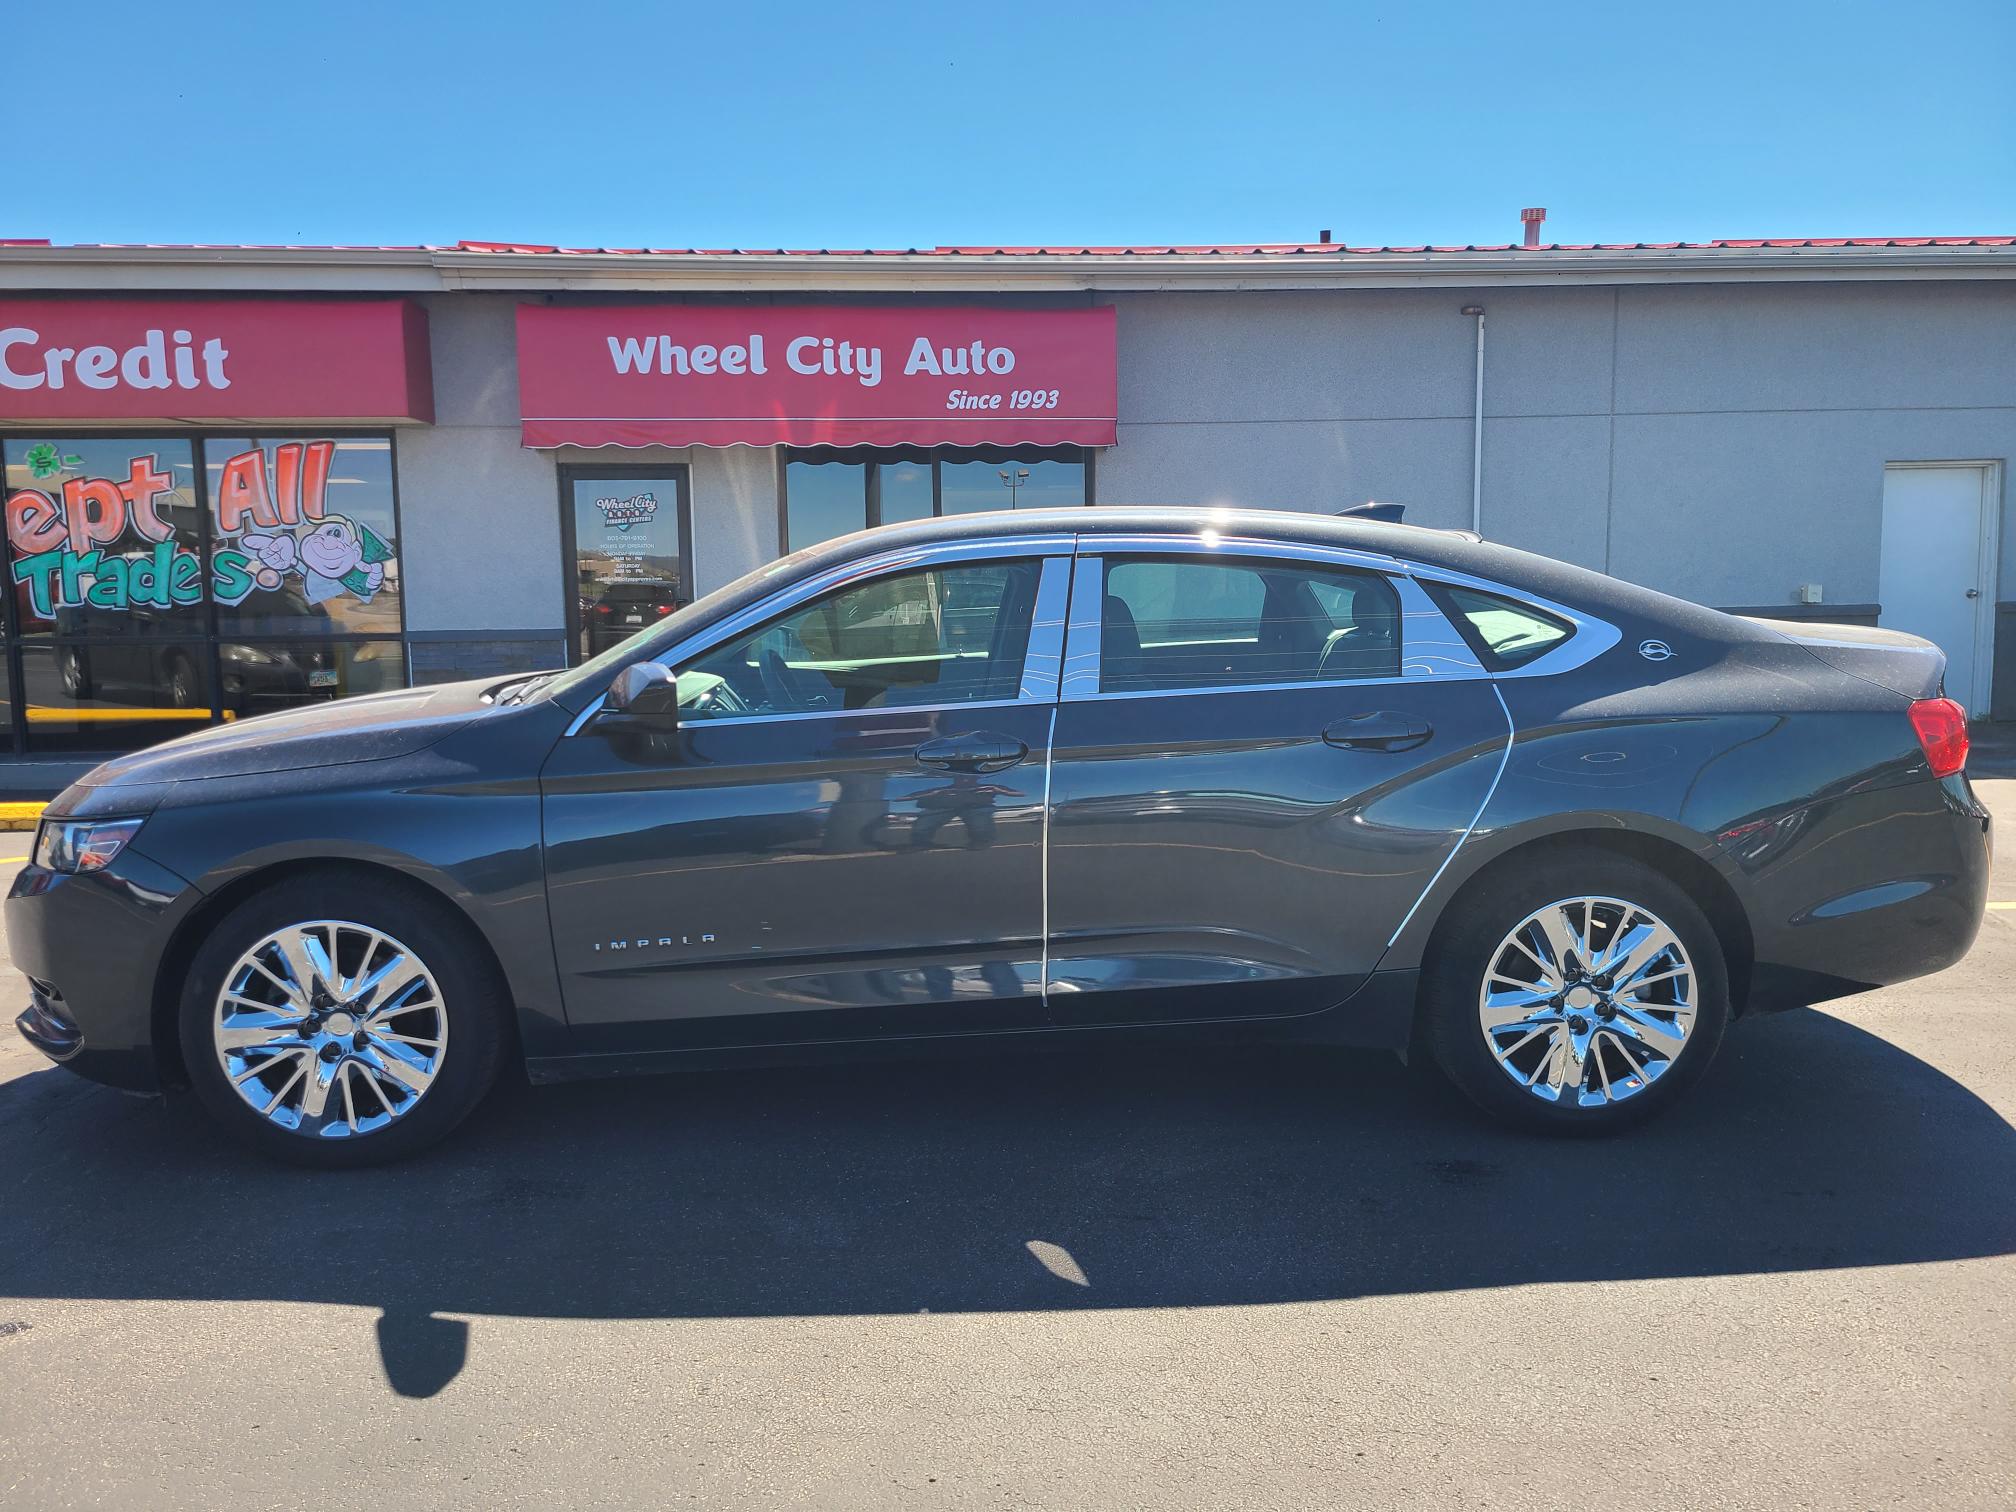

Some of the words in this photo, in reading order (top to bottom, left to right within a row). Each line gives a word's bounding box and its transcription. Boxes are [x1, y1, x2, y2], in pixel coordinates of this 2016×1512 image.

[0, 327, 231, 390] Credit
[606, 334, 769, 375] Wheel
[786, 335, 882, 387] City
[903, 337, 1016, 376] Auto
[946, 389, 1002, 410] Since
[1009, 389, 1060, 410] 1993
[6, 453, 175, 556] ept
[219, 439, 337, 533] All
[596, 498, 635, 510] Wheel
[635, 495, 657, 513] City
[13, 540, 254, 619] Trades
[595, 934, 716, 951] IMPALA
